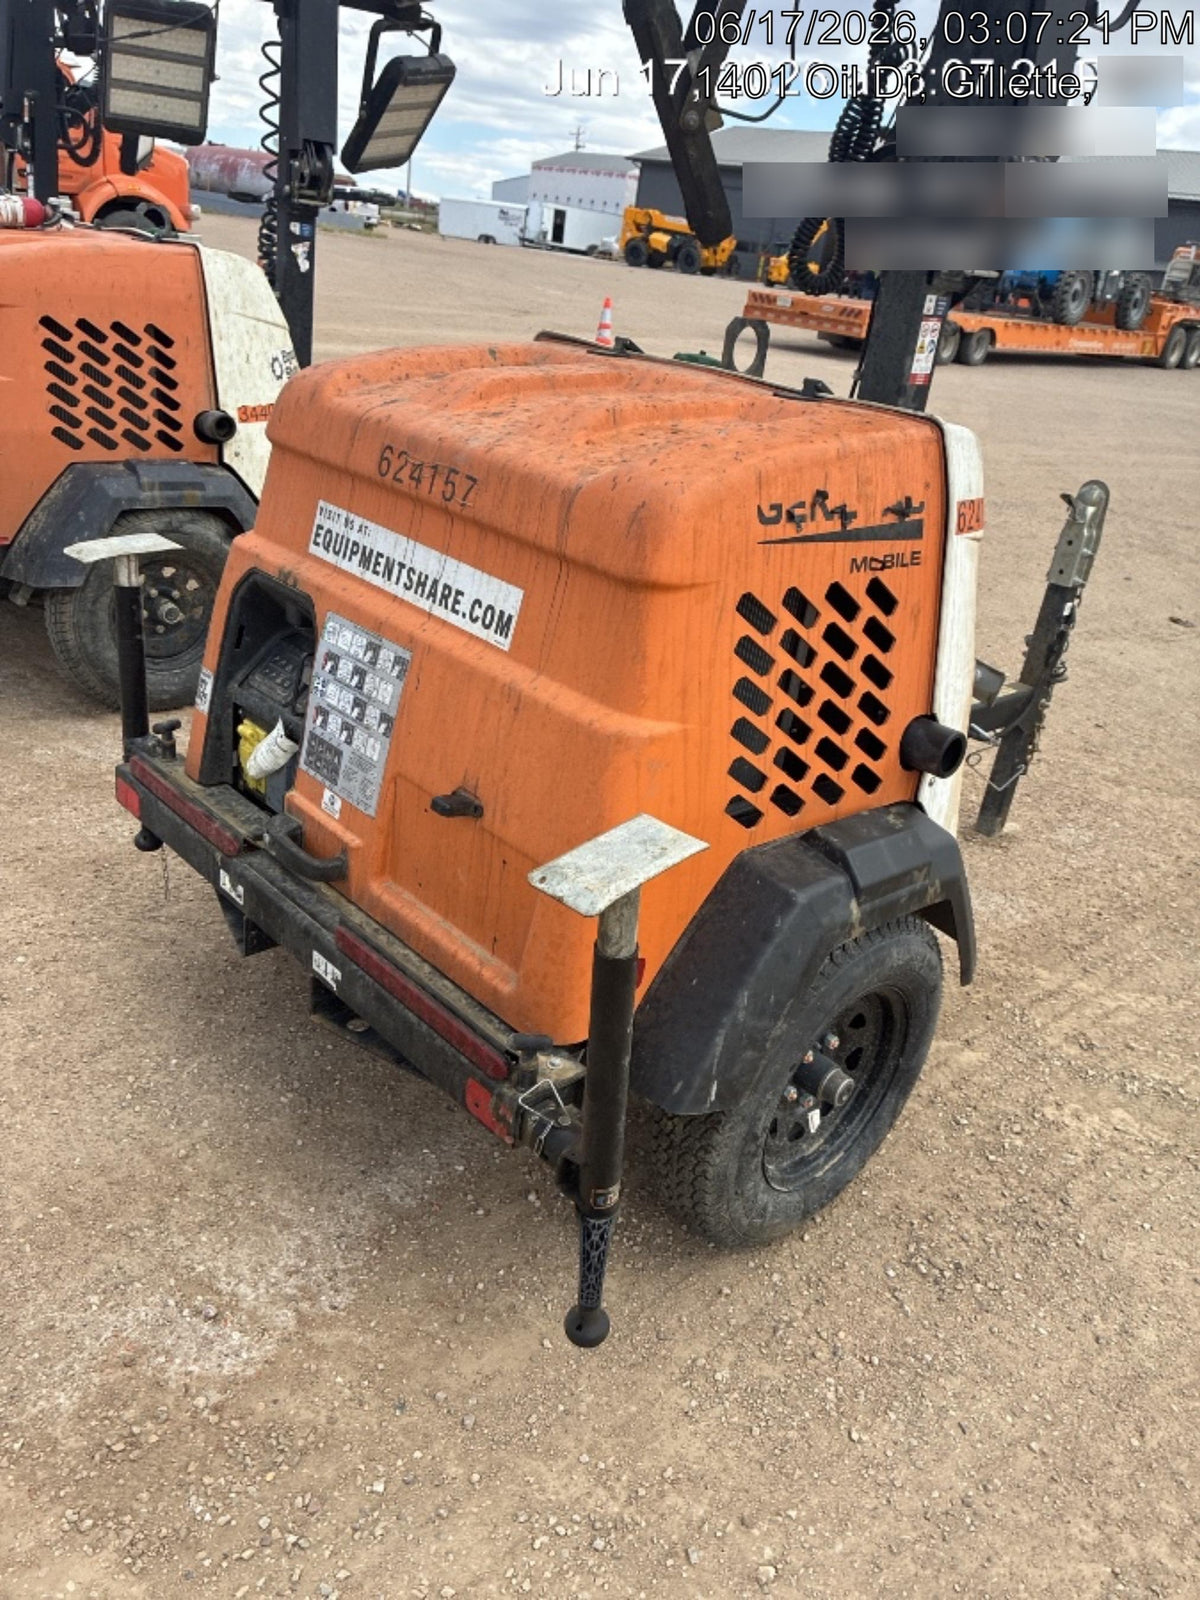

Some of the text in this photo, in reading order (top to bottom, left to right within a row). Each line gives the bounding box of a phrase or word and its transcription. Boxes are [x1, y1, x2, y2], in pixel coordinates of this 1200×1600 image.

[378, 444, 478, 507] 624157
[312, 523, 513, 640] EQUIPMENTSHARE.COM
[849, 549, 922, 575] MOBILE
